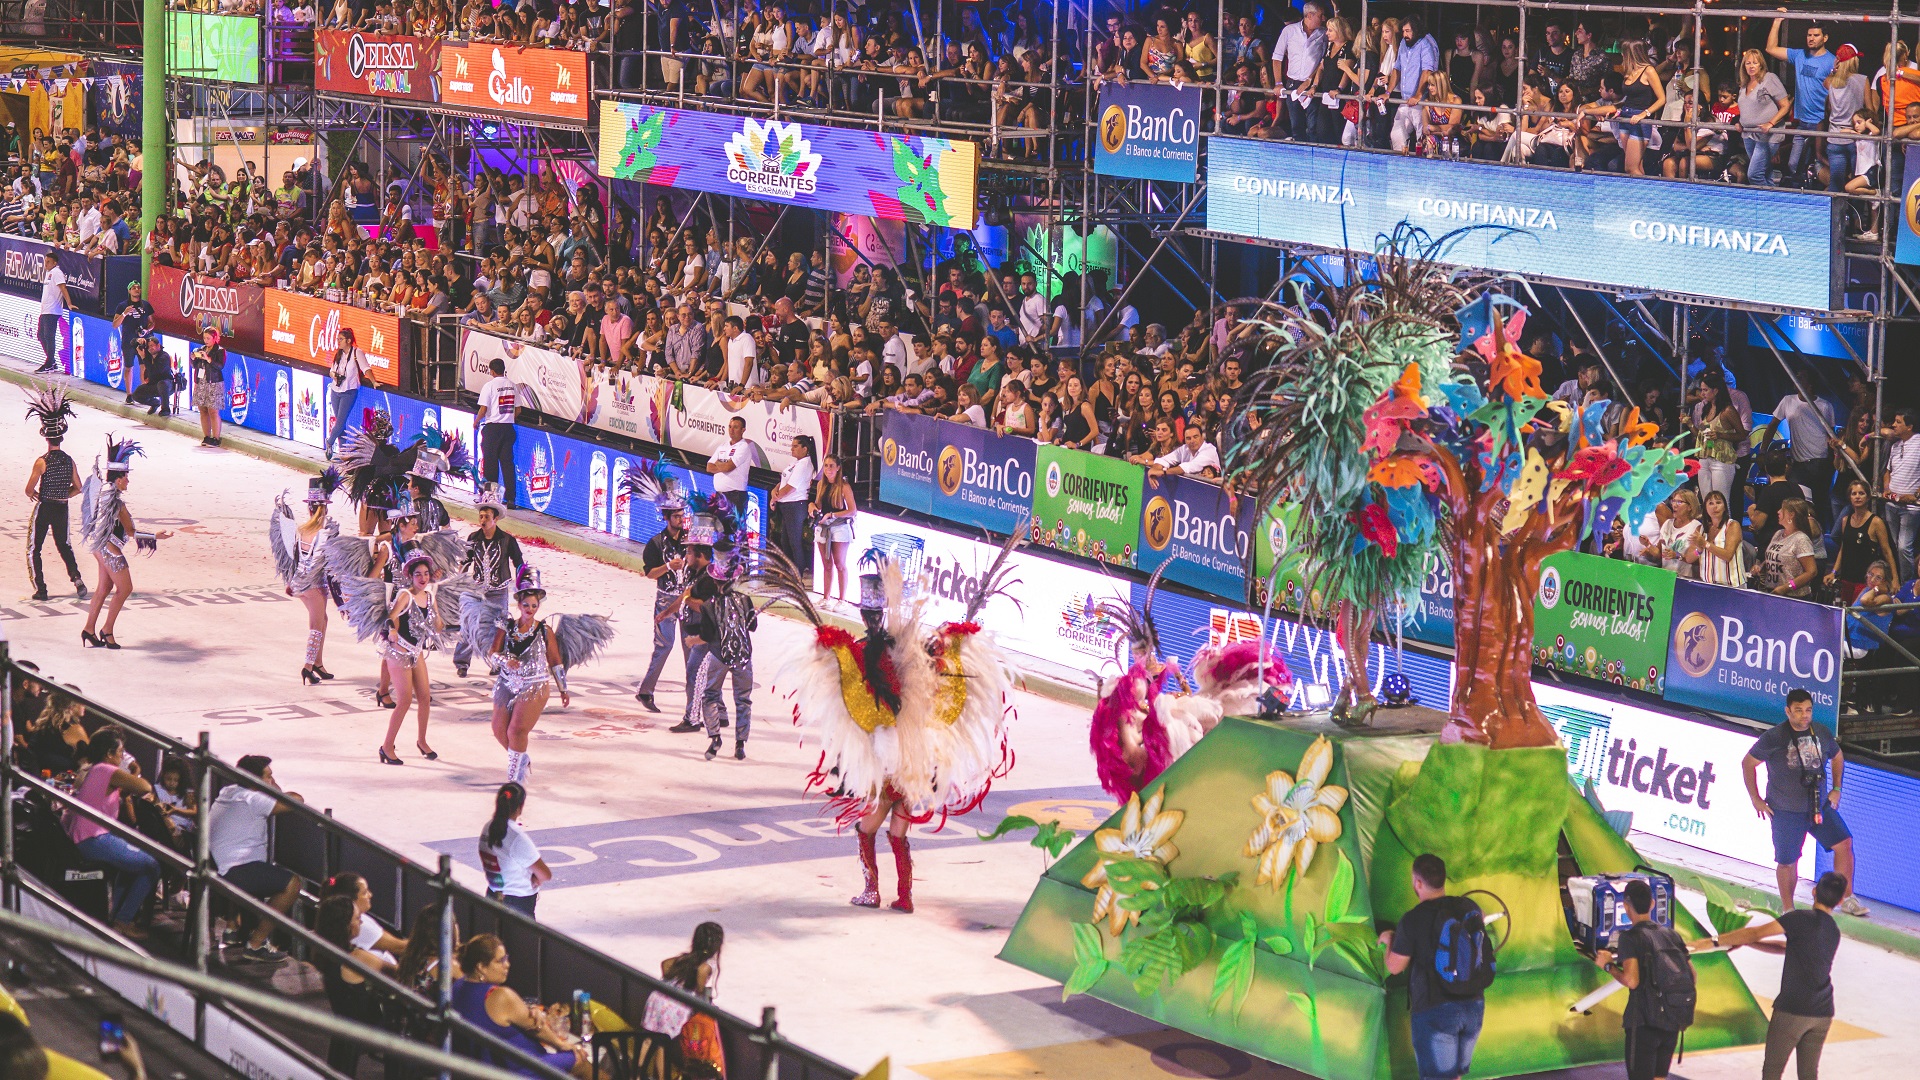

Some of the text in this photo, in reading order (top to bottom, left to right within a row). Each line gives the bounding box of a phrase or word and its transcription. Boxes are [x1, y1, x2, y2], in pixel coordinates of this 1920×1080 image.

[367, 70, 411, 94] CARNAVAL
[488, 67, 532, 106] Gallo
[550, 91, 578, 104] supermax
[1127, 105, 1196, 145] BanCo
[1126, 144, 1194, 161] El Banco de Corrientes
[729, 168, 814, 192] CORRIENTES
[758, 185, 793, 197] CARNAVAL
[1233, 175, 1356, 207] CONFIANZA
[1418, 198, 1558, 230] CONFIANZA
[1629, 219, 1790, 256] CONFIANZA
[309, 309, 341, 358] Calli
[364, 353, 390, 369] upermax
[626, 421, 637, 434] 2020
[688, 418, 726, 436] CORRIENTES
[898, 445, 934, 472] BanCo
[963, 447, 1032, 499] BanCo
[961, 488, 1030, 516] El Banco de Corrientes
[1062, 472, 1129, 507] CORRIENTES
[1067, 497, 1126, 525] somos todos!
[1173, 499, 1249, 560] BanCo
[1180, 546, 1200, 564] Banco
[1202, 554, 1210, 567] de
[1770, 543, 1784, 552] WE
[1766, 562, 1784, 574] OCK
[1767, 573, 1780, 583] OU
[1563, 579, 1655, 623] CORRIENTES
[1058, 626, 1117, 652] CORRIENTE
[1570, 609, 1650, 643] somos todos!
[1720, 615, 1835, 683] BanCo
[1719, 668, 1833, 706] El Banco de Contes
[1663, 812, 1707, 837] .com
